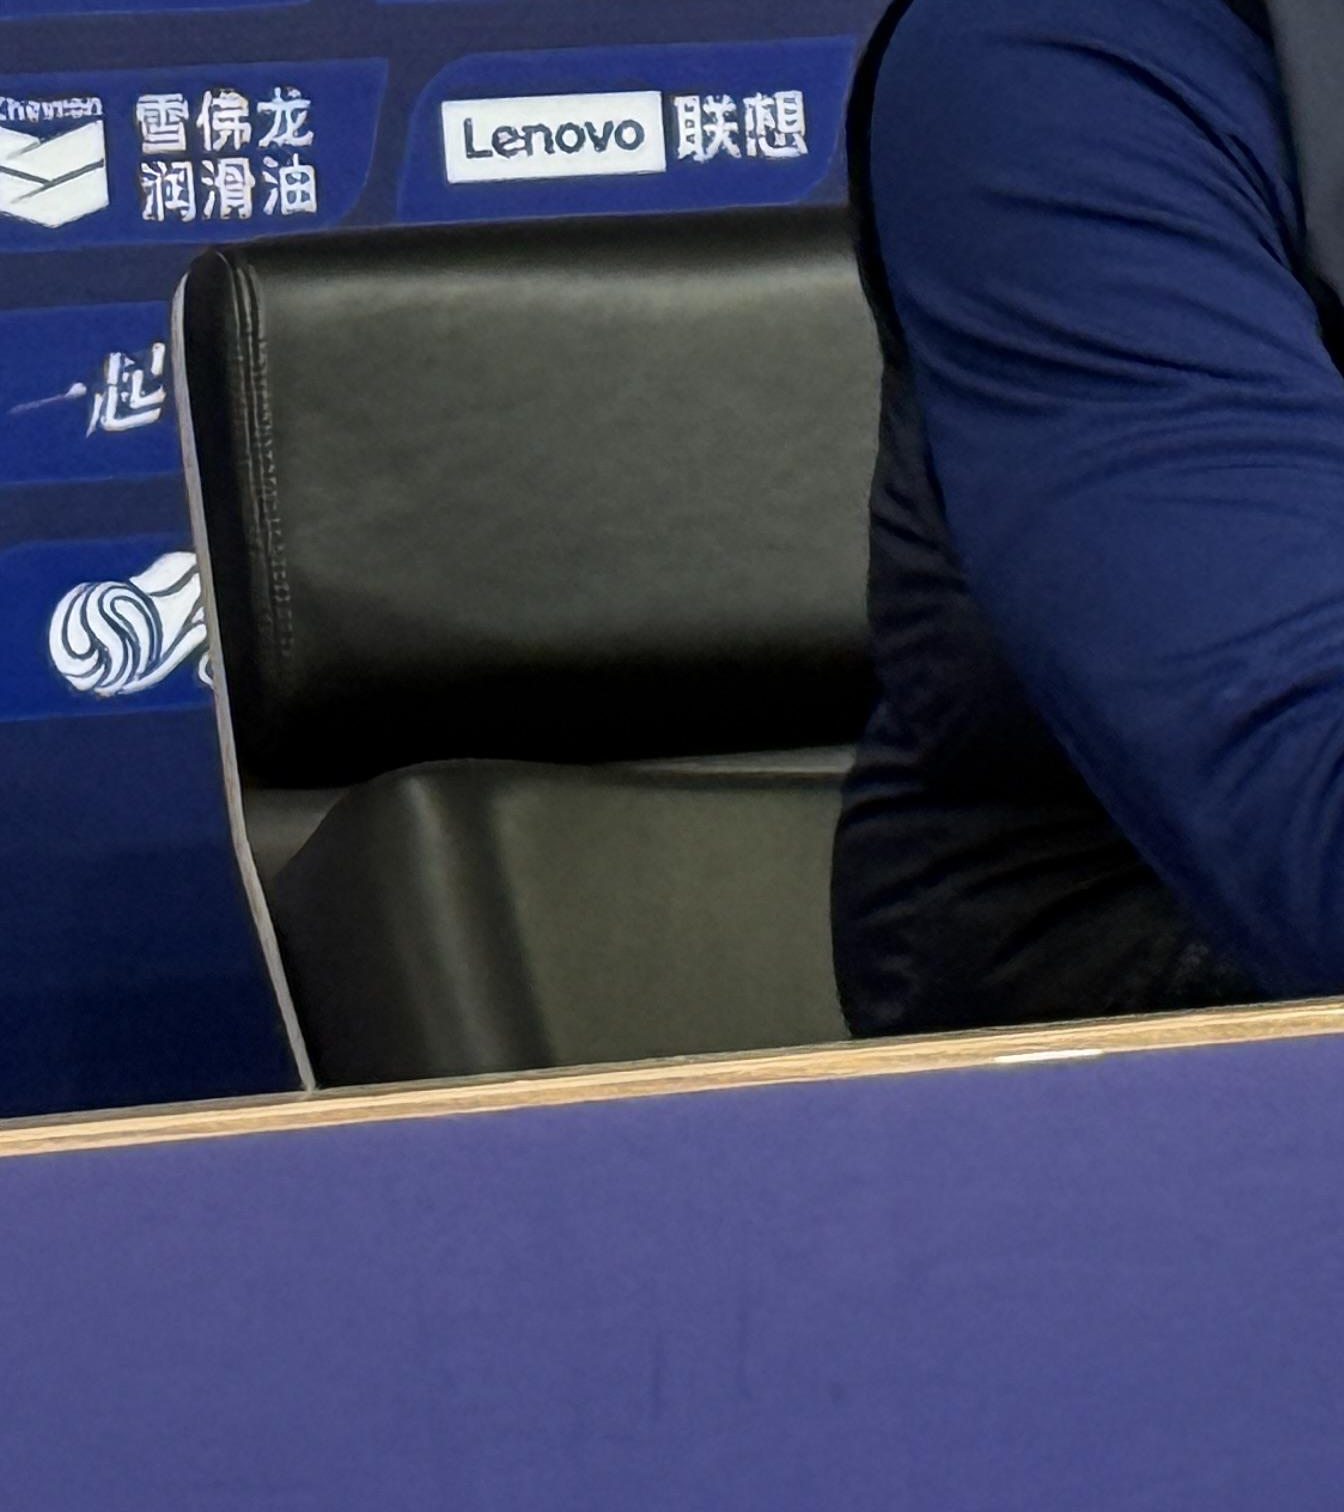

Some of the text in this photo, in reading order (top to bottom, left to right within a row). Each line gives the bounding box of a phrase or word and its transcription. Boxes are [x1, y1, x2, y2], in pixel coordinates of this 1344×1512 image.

[136, 87, 314, 152] 雪佛龙
[464, 91, 807, 161] Lenovo 联想
[141, 153, 316, 221] 润滑油
